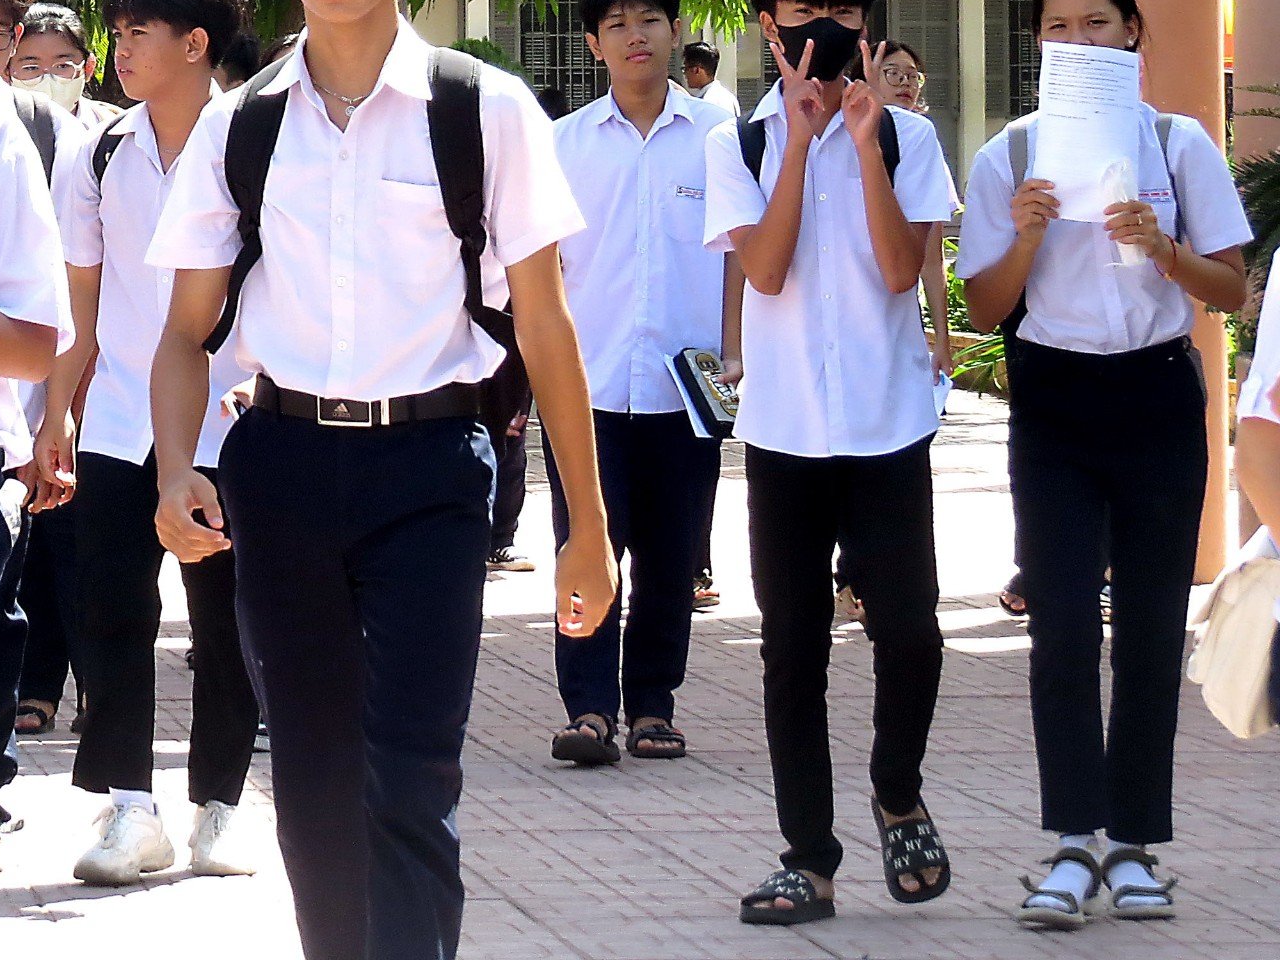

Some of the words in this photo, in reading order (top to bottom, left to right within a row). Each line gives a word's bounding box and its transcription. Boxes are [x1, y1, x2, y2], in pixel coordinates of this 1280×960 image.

[887, 828, 902, 843] NY
[905, 839, 921, 851] NY
[923, 849, 940, 860] NY
[893, 854, 910, 869] NY
